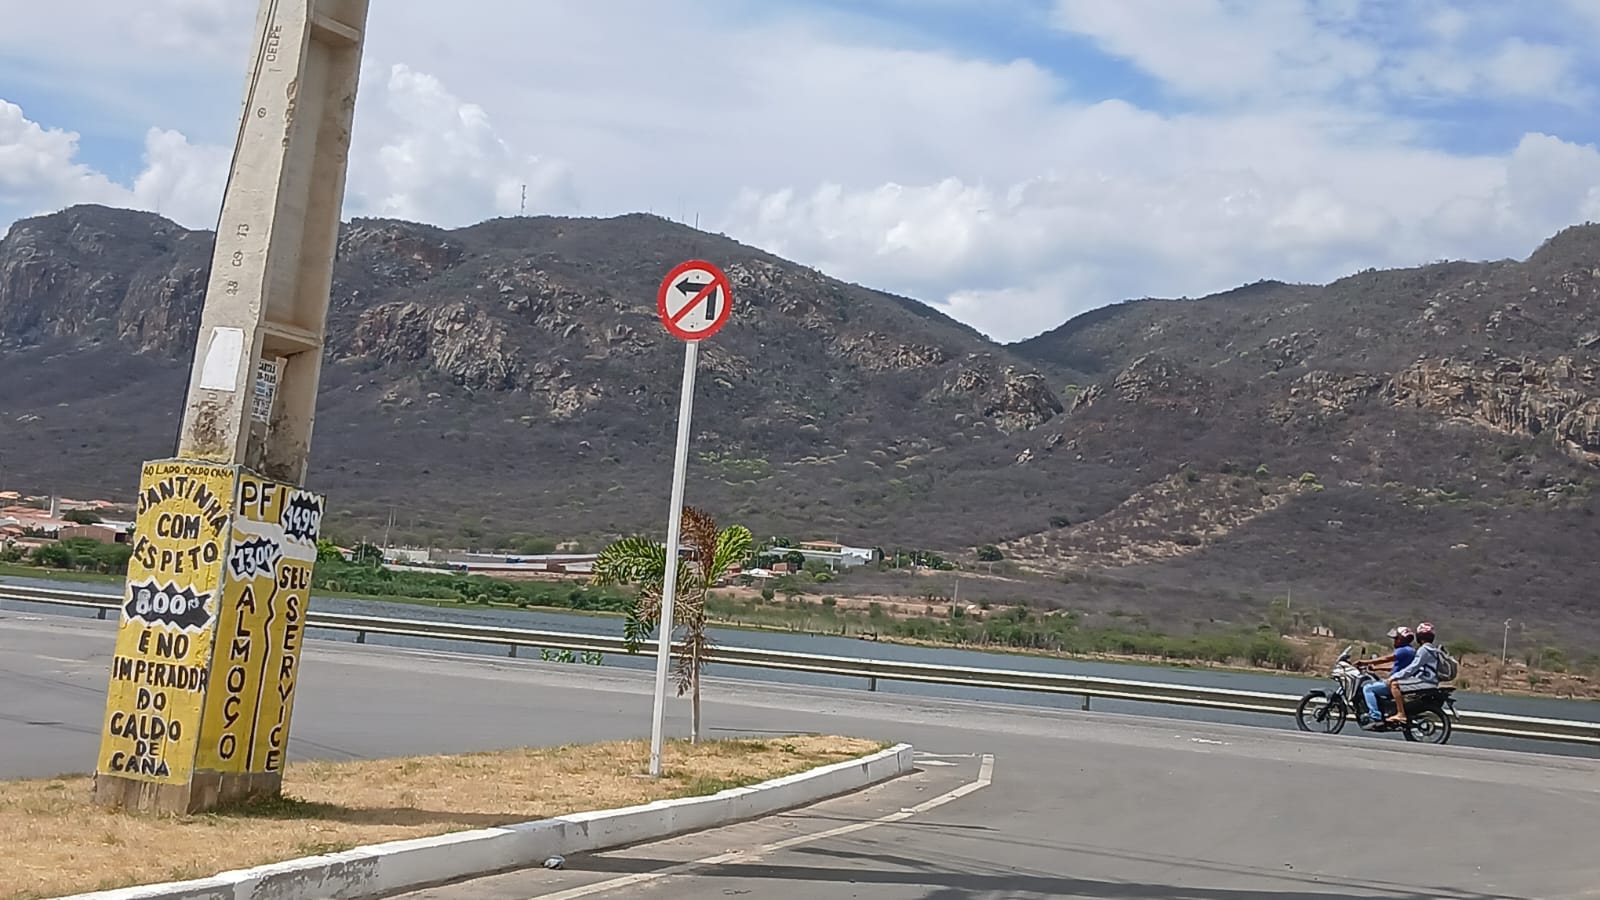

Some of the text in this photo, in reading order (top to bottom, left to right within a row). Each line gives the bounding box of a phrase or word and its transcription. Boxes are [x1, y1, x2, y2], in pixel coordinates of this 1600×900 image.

[143, 466, 154, 476] AO
[156, 464, 180, 475] LADO
[139, 476, 228, 538] JANTINHA
[240, 481, 276, 516] PF
[158, 513, 201, 539] COM
[135, 535, 219, 573] ESPETO
[156, 632, 189, 659] NO
[113, 656, 208, 693] IMPERADOR
[219, 586, 255, 760] ALMOÇO
[265, 596, 299, 770] SERVICE
[136, 687, 167, 711] DO
[110, 712, 182, 742] CALDO
[136, 740, 160, 756] DE
[111, 752, 170, 777] CANA
